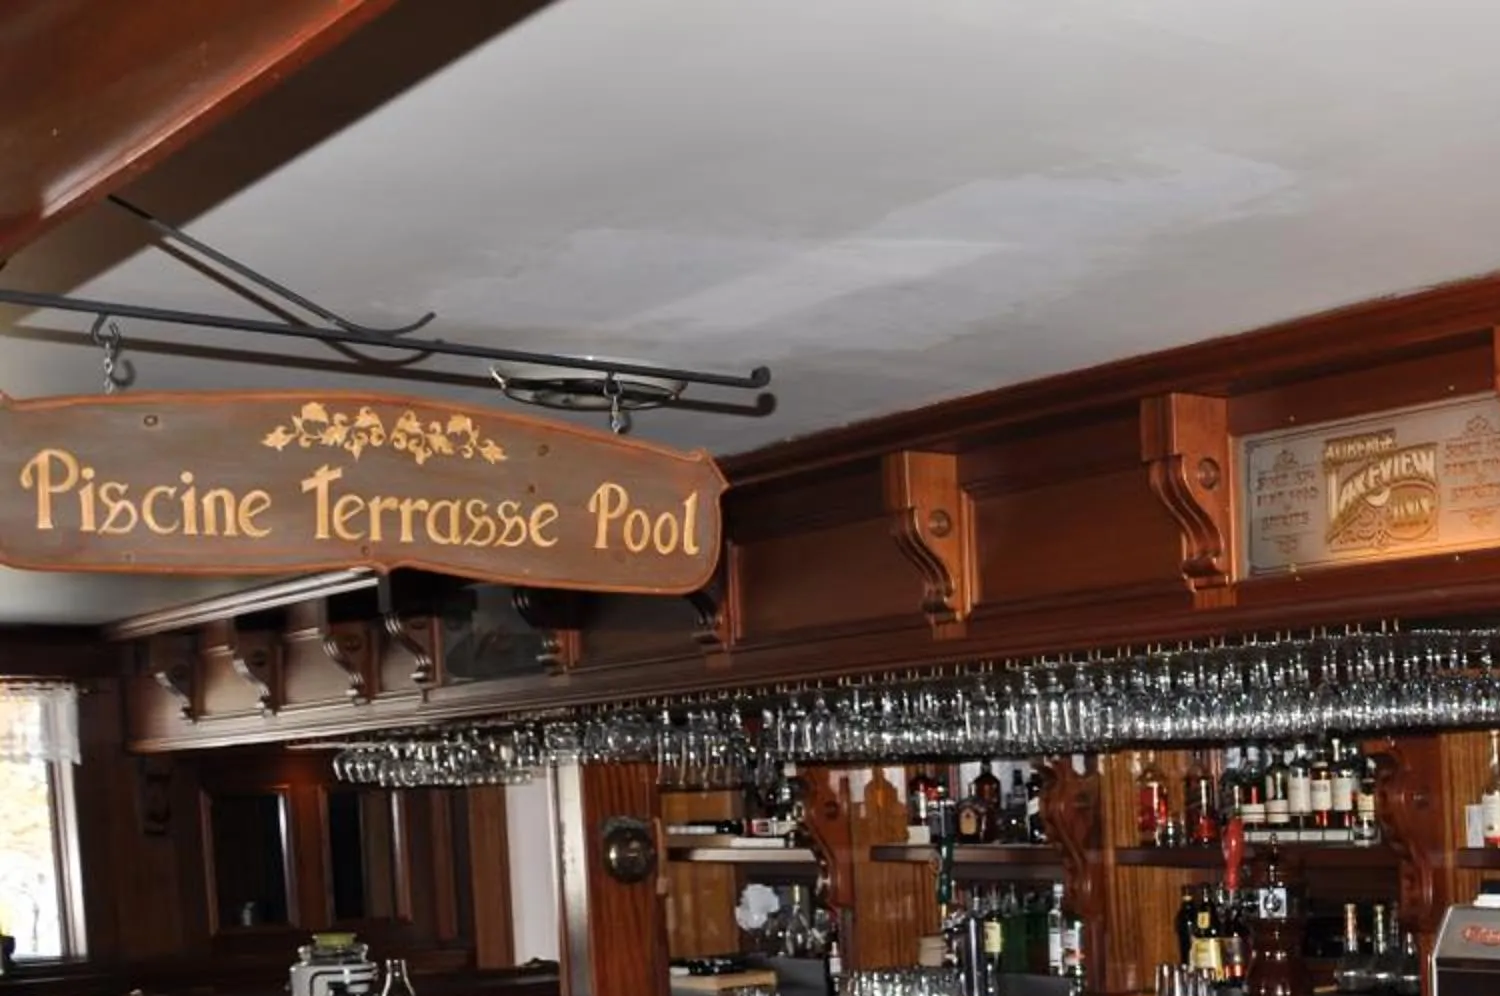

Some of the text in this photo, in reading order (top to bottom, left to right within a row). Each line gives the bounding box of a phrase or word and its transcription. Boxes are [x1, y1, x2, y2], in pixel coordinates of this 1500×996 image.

[20, 449, 700, 556] Piscine Terrasse Pool
[1327, 449, 1436, 523] LAKEVIEW
